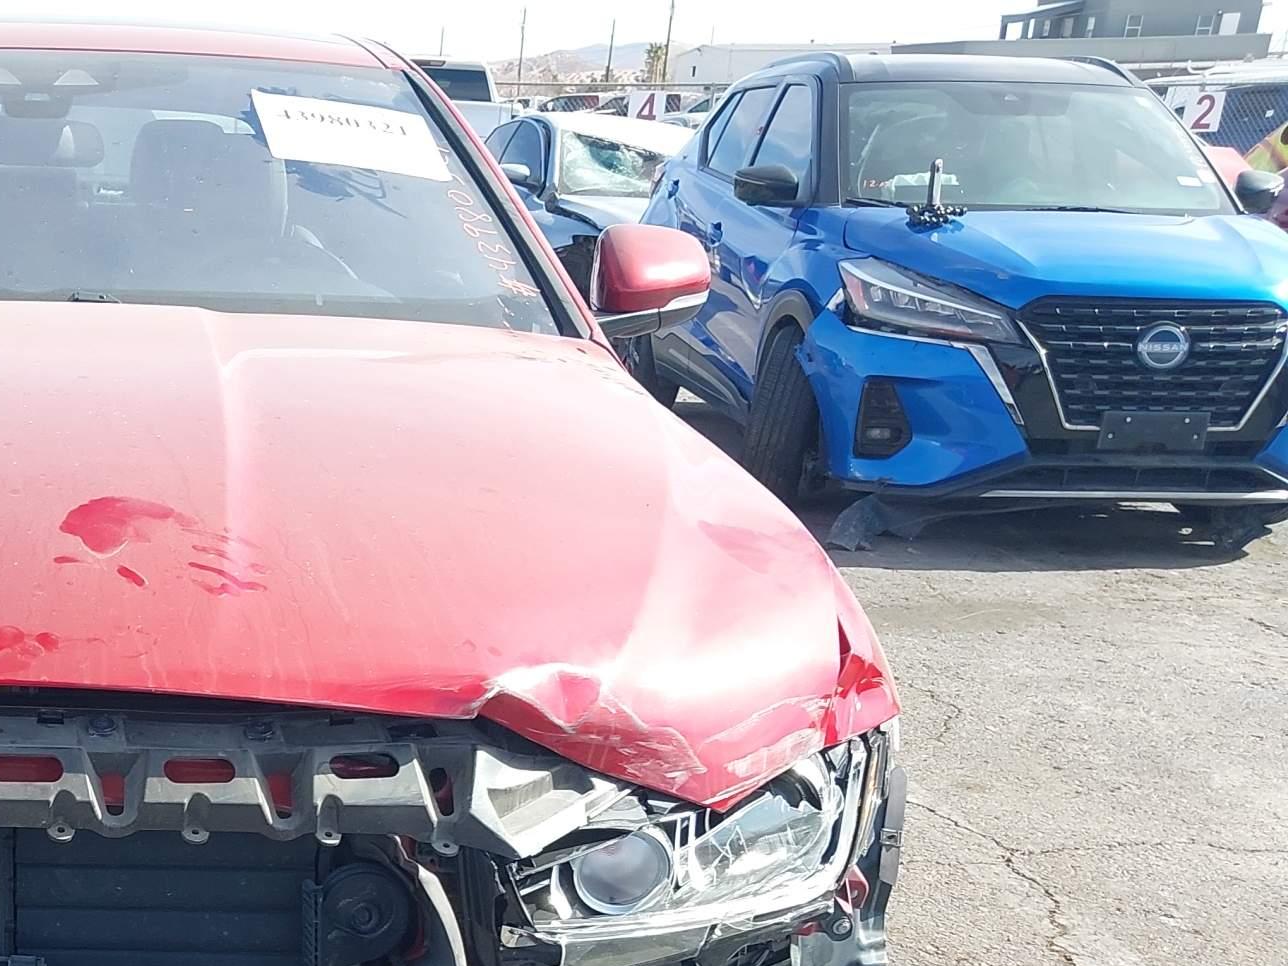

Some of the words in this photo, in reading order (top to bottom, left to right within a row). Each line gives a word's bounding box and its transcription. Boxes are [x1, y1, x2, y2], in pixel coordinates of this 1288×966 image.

[636, 92, 657, 120] 4
[1190, 94, 1216, 130] 2
[1137, 342, 1189, 352] NISSAN
